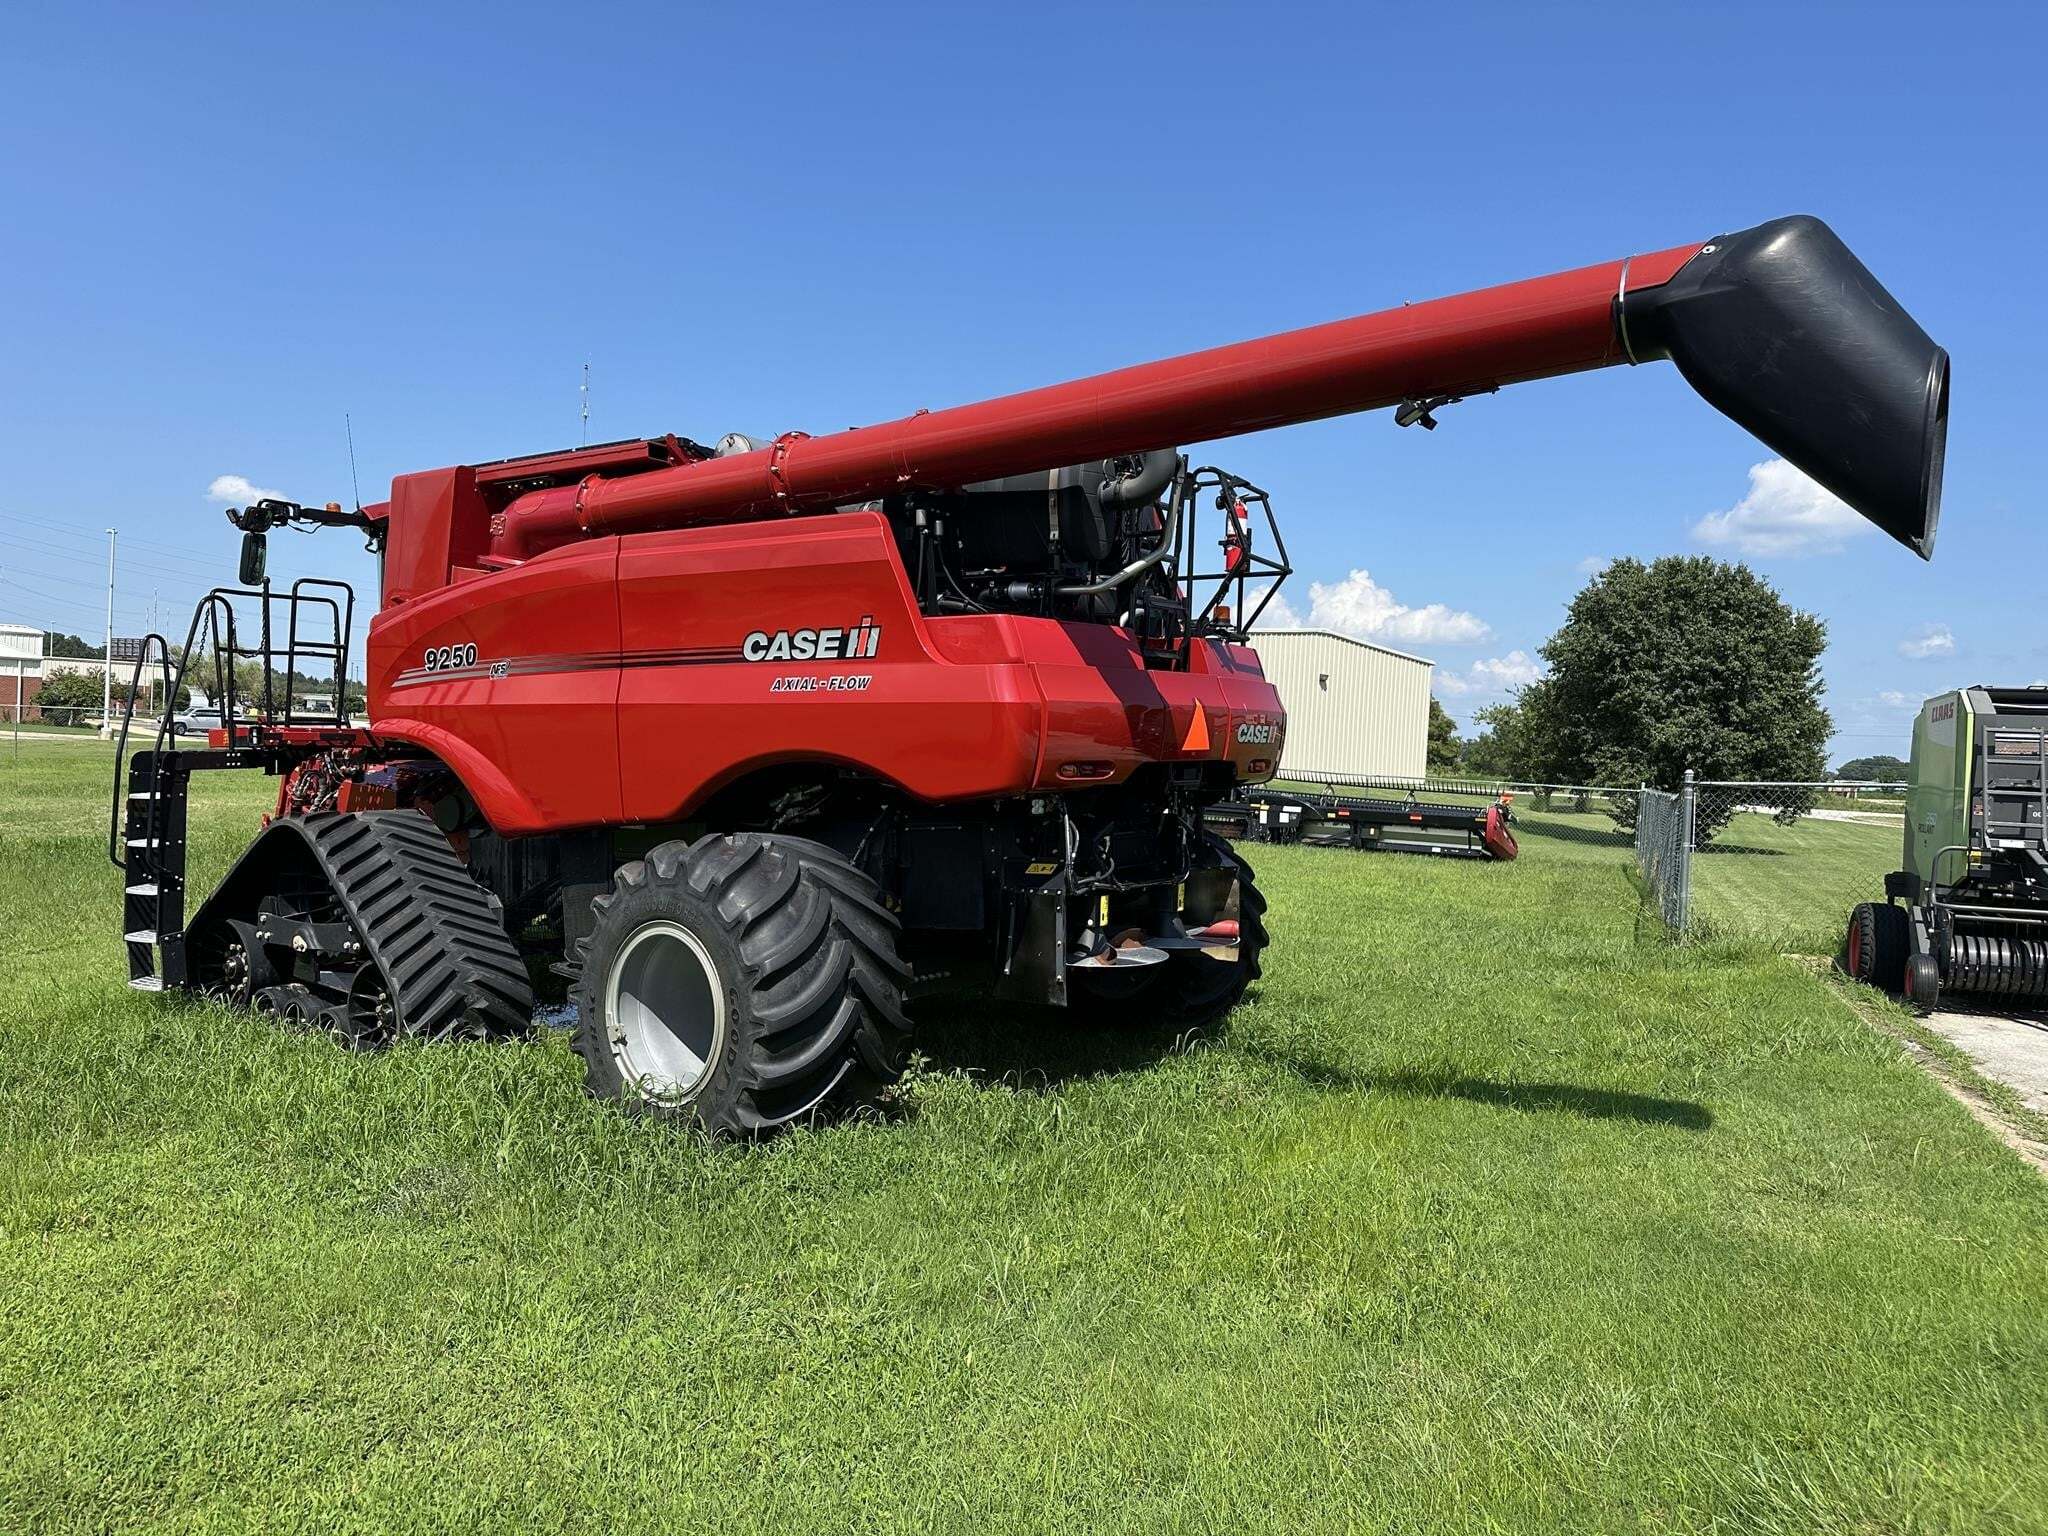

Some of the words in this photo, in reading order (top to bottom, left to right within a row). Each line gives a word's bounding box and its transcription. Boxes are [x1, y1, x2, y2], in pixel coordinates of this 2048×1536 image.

[742, 630, 843, 662] CASE
[425, 642, 479, 673] 9250
[770, 675, 872, 692] AXIAL-FLOW
[1931, 702, 1954, 723] CLAAS
[1237, 723, 1269, 744] CASE
